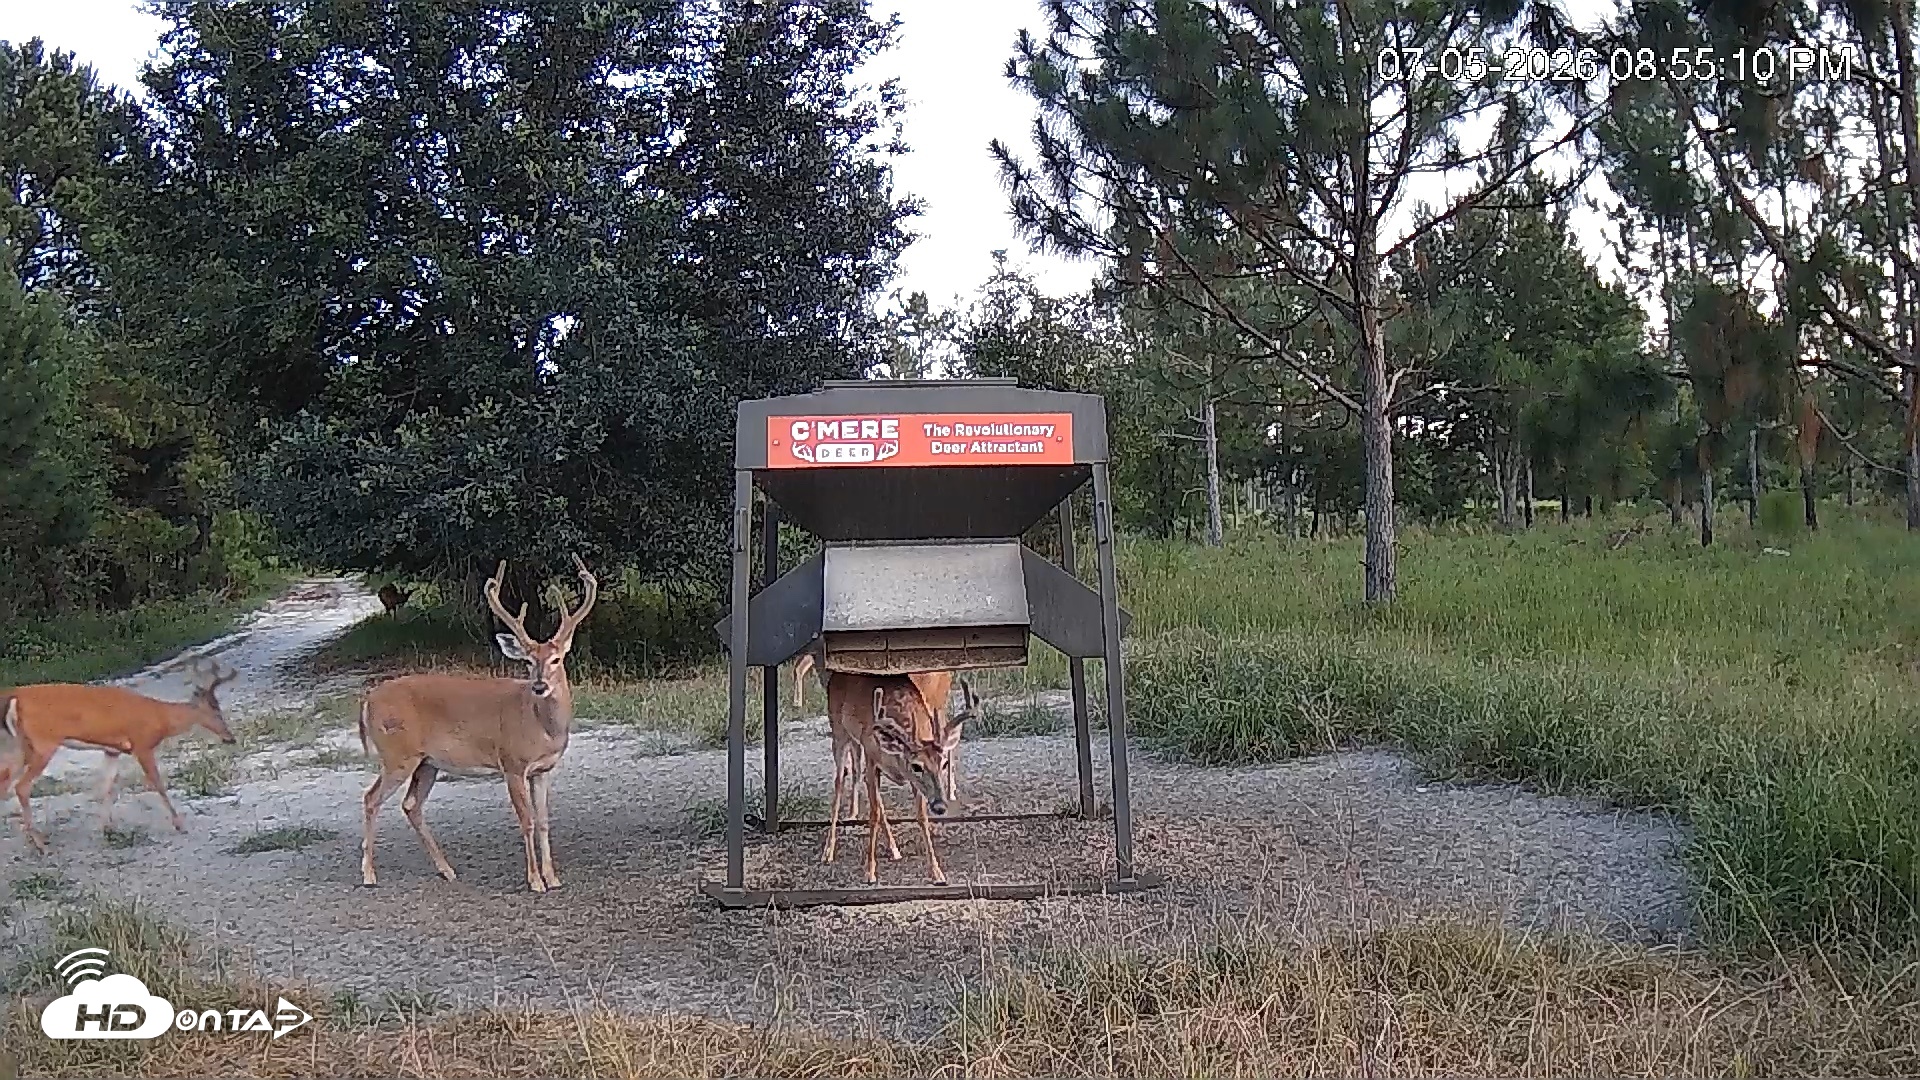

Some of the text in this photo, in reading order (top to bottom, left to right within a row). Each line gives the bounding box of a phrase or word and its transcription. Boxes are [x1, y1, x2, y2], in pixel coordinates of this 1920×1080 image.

[791, 419, 899, 440] C'MERE
[924, 423, 1055, 438] The Revolutionary
[821, 446, 871, 459] DEER
[931, 441, 1044, 454] Deer Attractant
